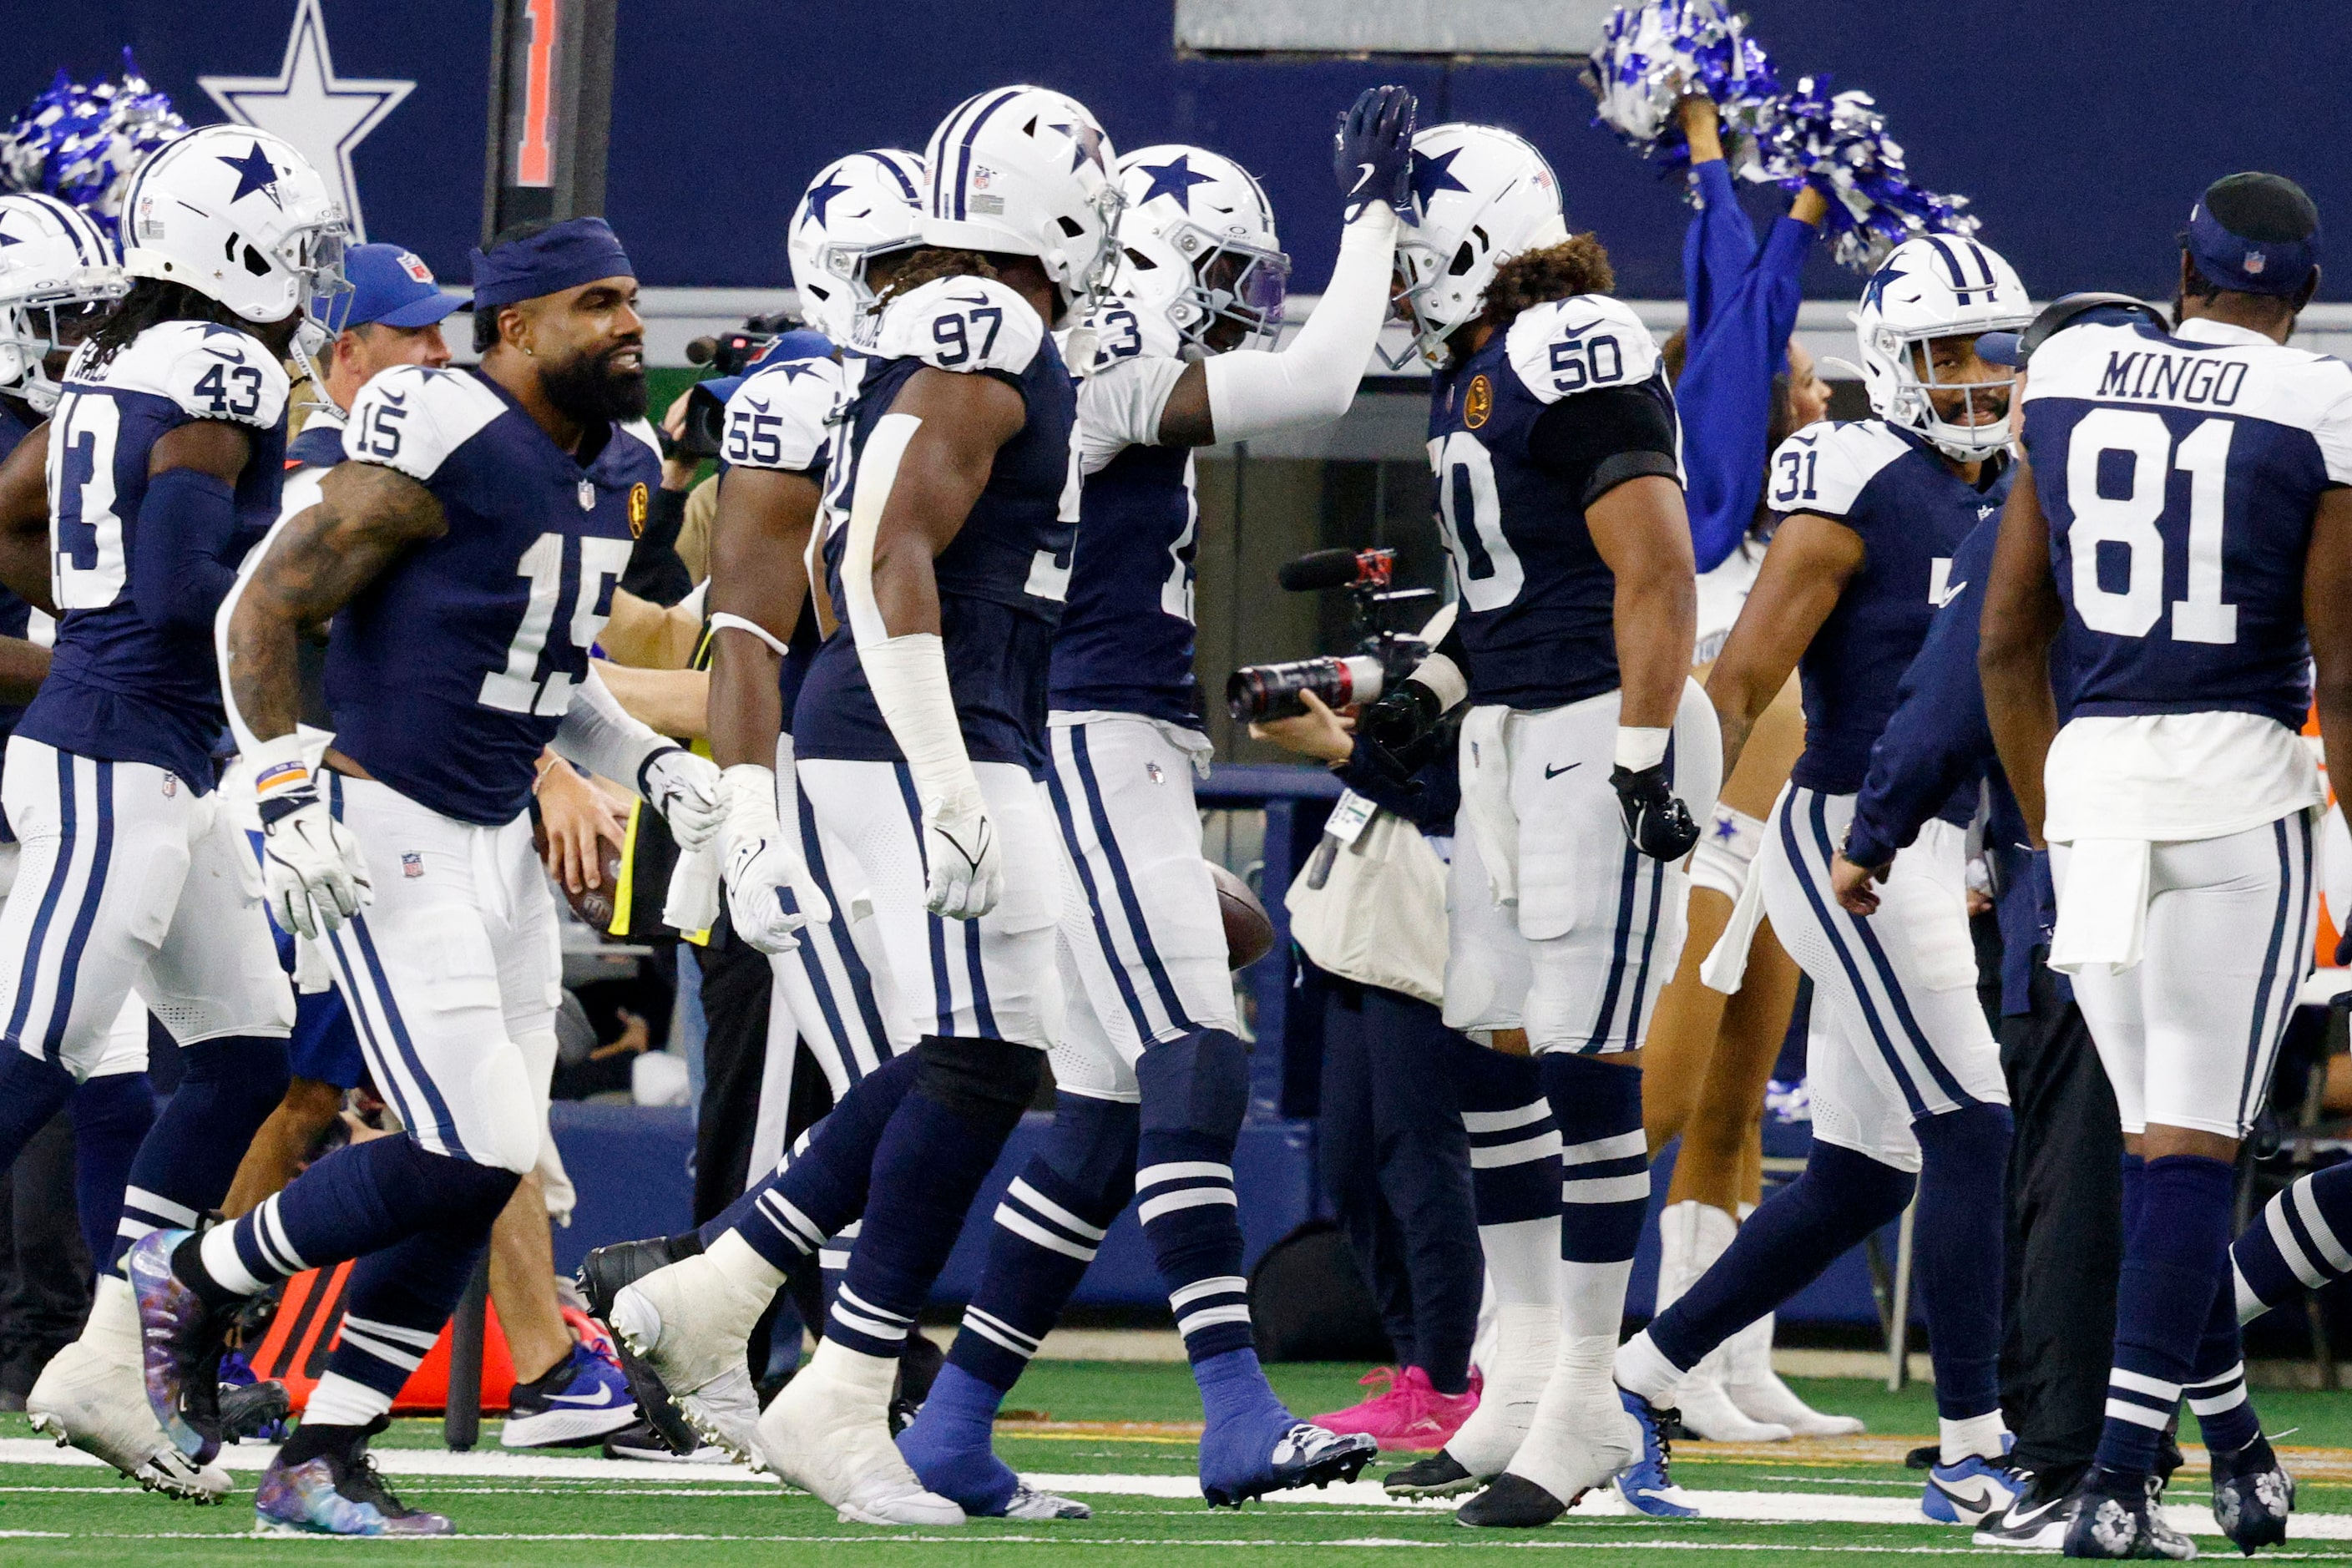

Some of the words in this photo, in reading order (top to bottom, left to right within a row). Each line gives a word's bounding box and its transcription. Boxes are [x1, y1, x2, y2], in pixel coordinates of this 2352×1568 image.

[517, 0, 554, 187] 1
[933, 308, 1002, 366] 97
[1084, 311, 1141, 365] 3
[1549, 335, 1623, 392] 50
[194, 364, 262, 416] 43
[2097, 351, 2248, 407] MINGO
[357, 402, 407, 458] 15
[729, 412, 783, 464] 55
[1776, 450, 1817, 502] 31
[2066, 407, 2238, 645] 81
